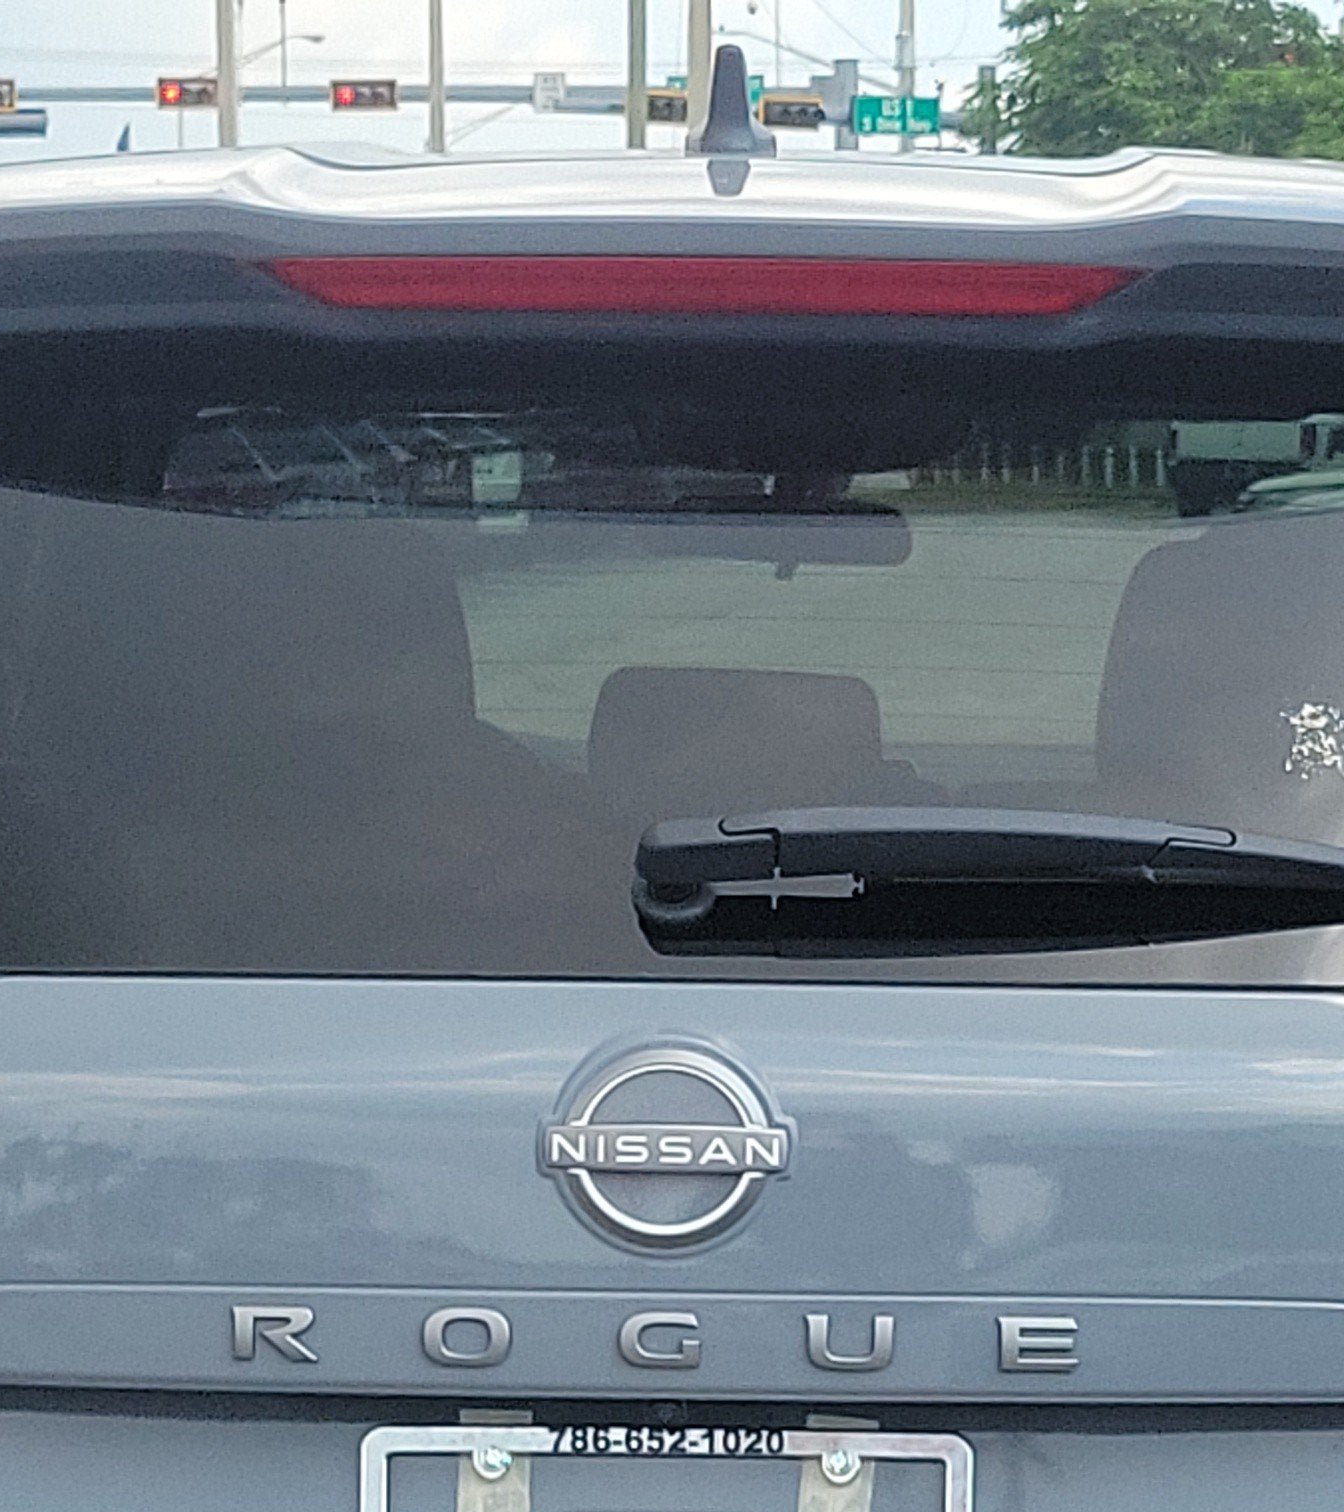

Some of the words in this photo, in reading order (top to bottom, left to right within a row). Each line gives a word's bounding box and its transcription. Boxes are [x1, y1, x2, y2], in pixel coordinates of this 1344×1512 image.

[550, 1133, 780, 1166] NISSAN
[230, 1305, 1081, 1373] ROGUE
[548, 1425, 785, 1456] 786-652-1020
